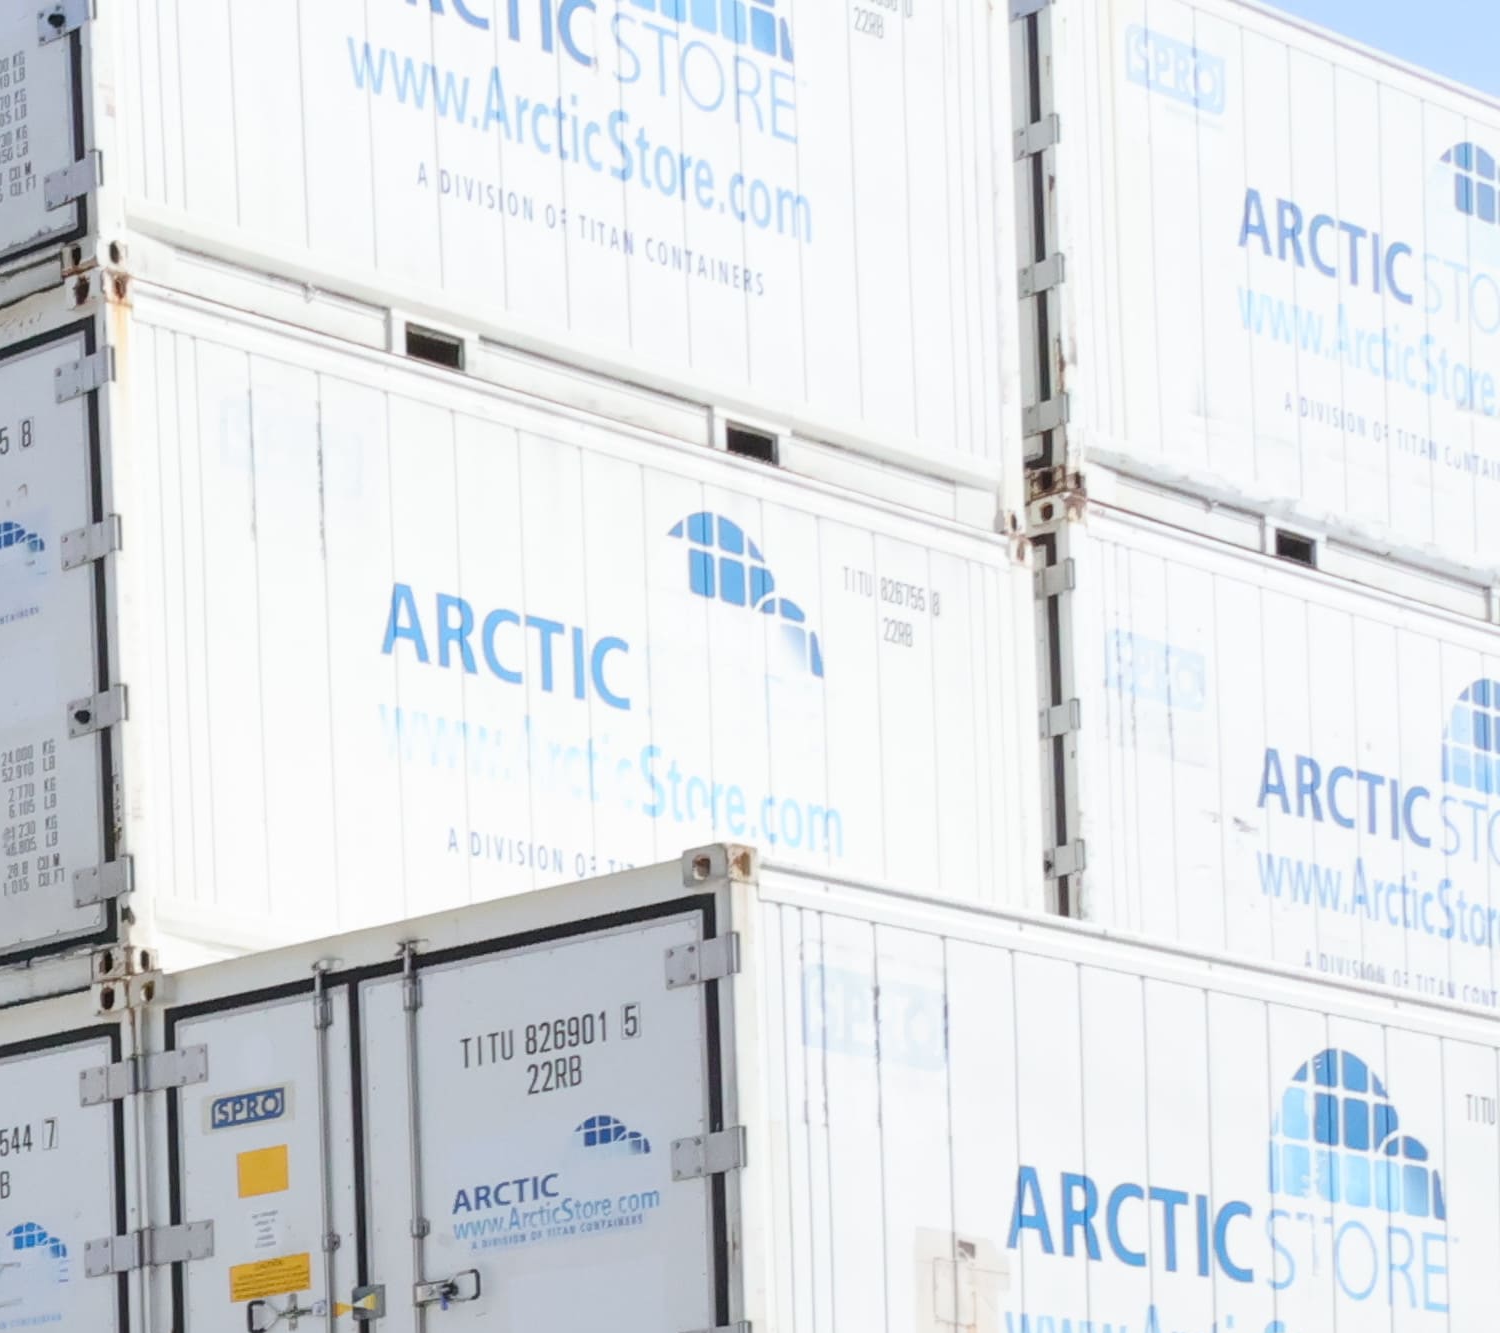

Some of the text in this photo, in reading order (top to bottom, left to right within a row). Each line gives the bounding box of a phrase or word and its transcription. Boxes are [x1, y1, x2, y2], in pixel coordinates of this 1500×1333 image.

[346, 35, 813, 244] www.ArcticStore.com
[417, 163, 428, 188] A
[440, 169, 533, 223] DIVISION
[579, 215, 634, 256] TITAN
[646, 238, 764, 296] CONTAINERS
[21, 420, 32, 448] 8
[381, 582, 630, 710] ARCTIC
[460, 1005, 637, 1069] TITU 826901 5
[528, 1055, 582, 1095] 22RB
[215, 1090, 282, 1127] SPRO
[46, 1120, 55, 1149] 7
[452, 1173, 559, 1215] ARCTIC
